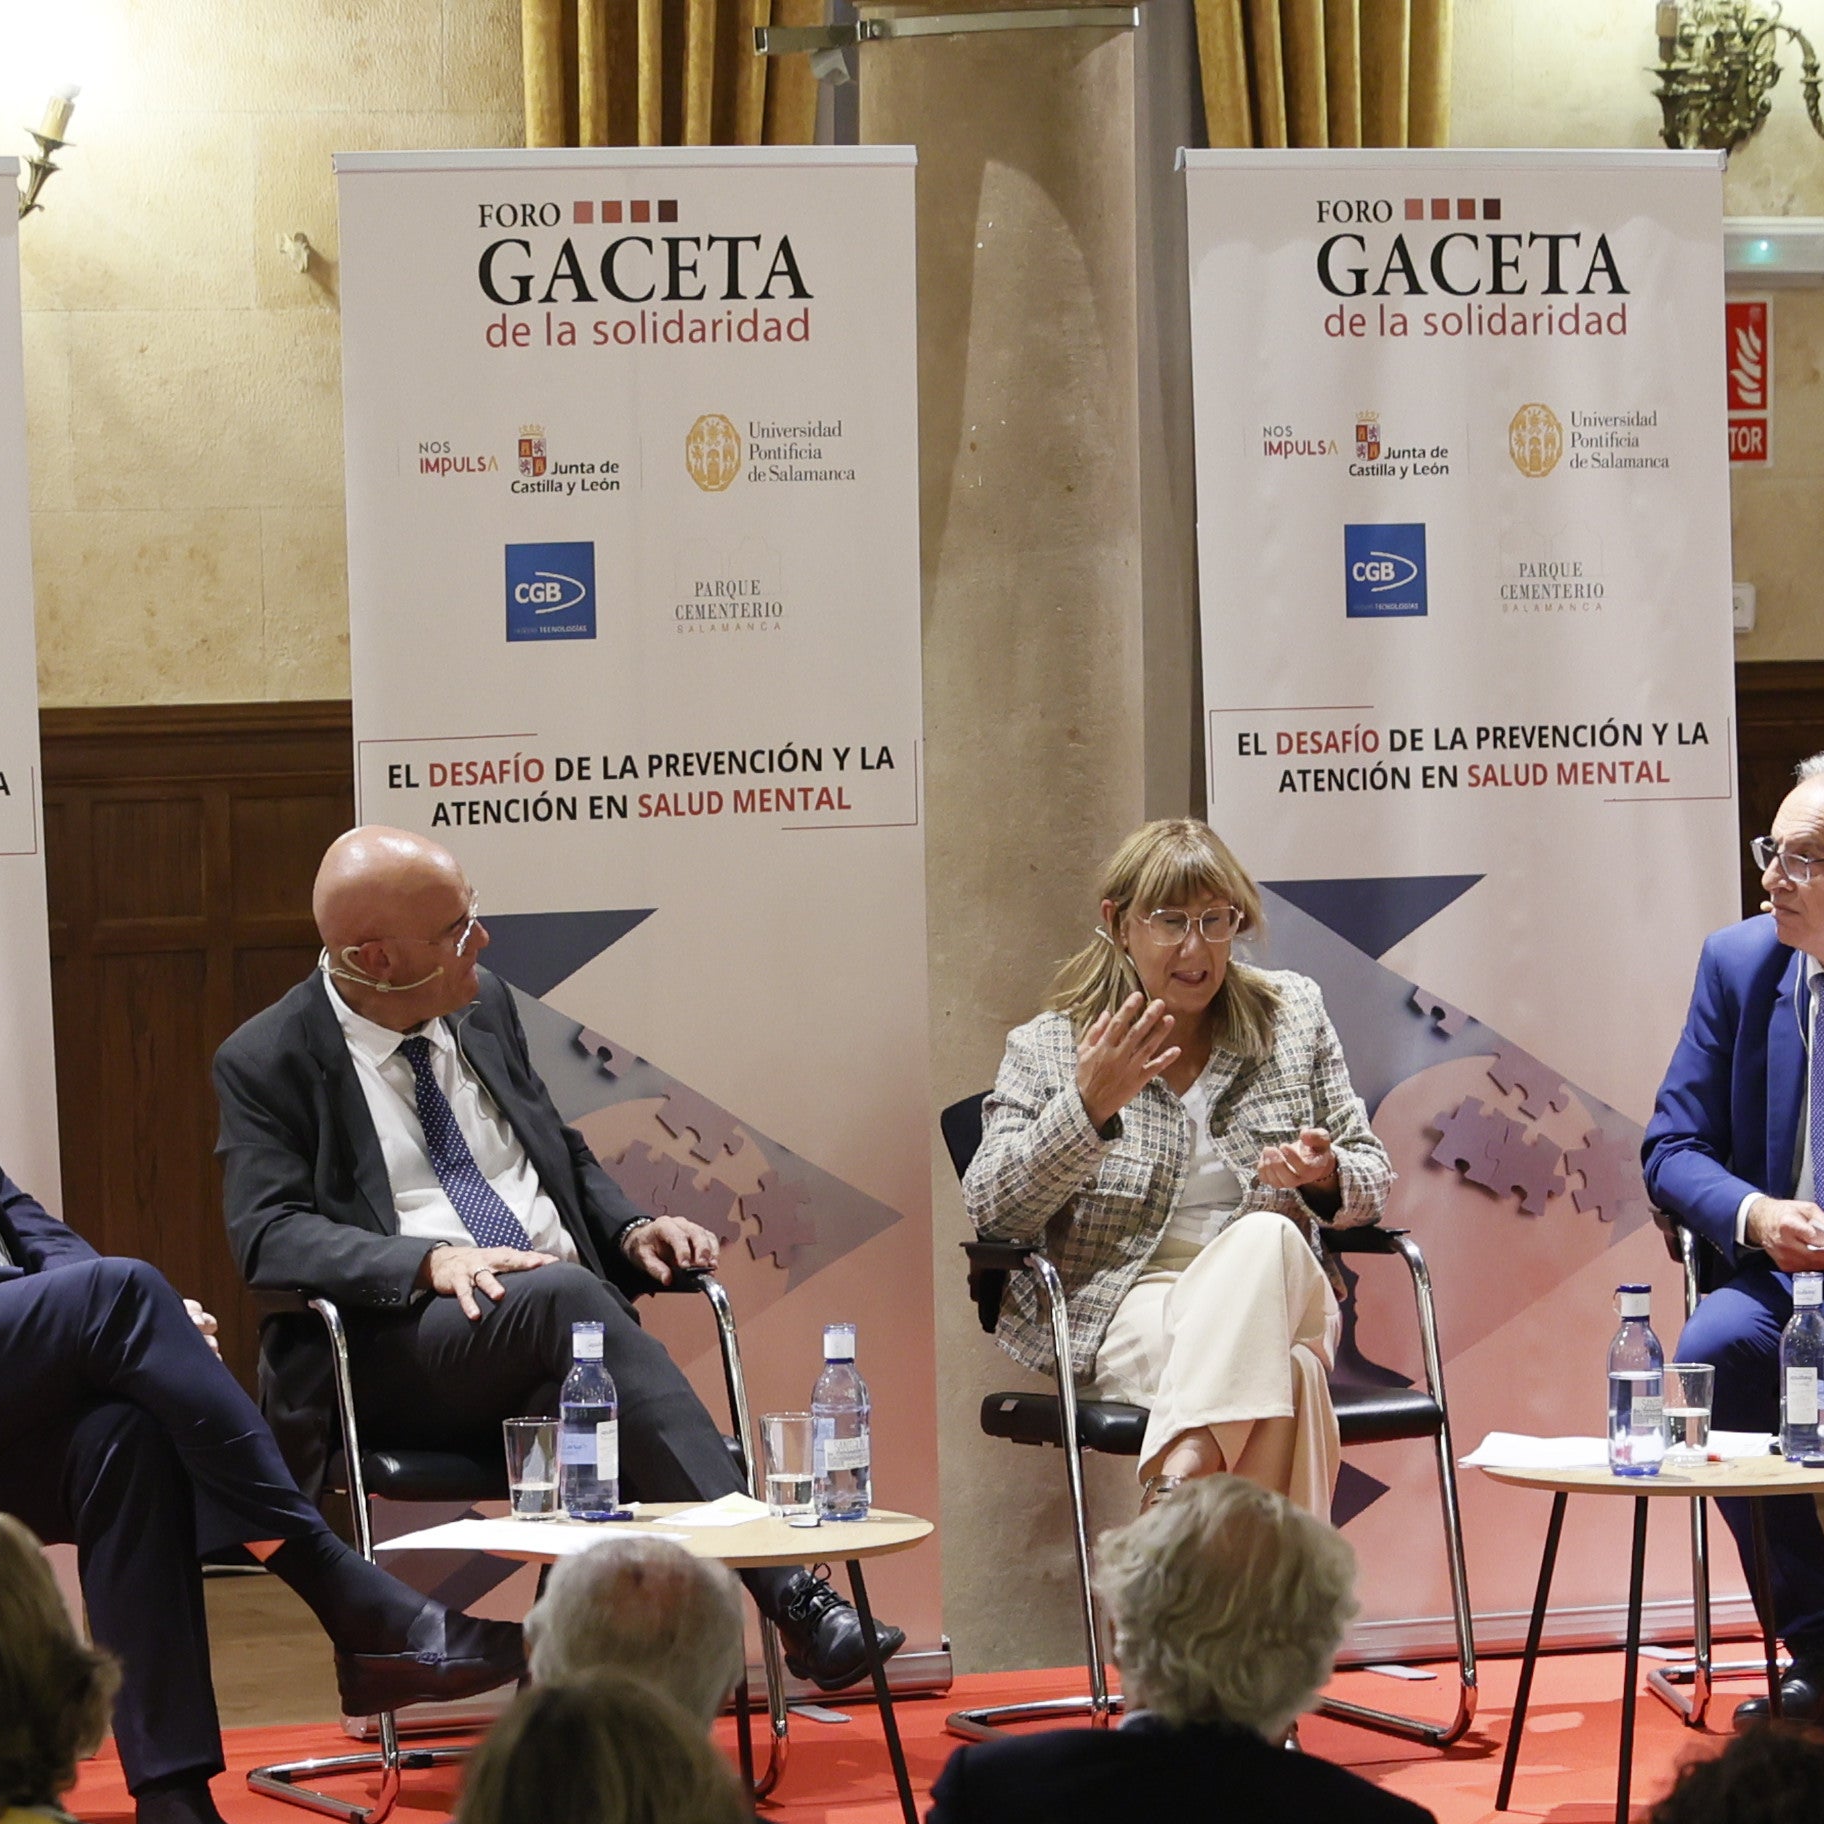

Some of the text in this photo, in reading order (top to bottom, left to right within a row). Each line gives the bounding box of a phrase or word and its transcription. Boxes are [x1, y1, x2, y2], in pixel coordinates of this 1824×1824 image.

[479, 203, 560, 227] FORO
[1317, 200, 1392, 223] FORO
[479, 234, 813, 305] GACETA
[1317, 231, 1630, 297] GACETA
[486, 308, 809, 348] de la solidaridad
[1325, 303, 1626, 337] de la solidaridad
[1572, 410, 1657, 427] Universidad
[750, 420, 841, 438] Universidad
[1263, 426, 1292, 438] NOS
[419, 441, 450, 453] NOS
[1572, 432, 1639, 448] Pontificia
[749, 443, 822, 460] Pontificia
[1384, 446, 1448, 459] Junta de
[1570, 452, 1669, 468] de Salamanca
[551, 461, 619, 475] Junta de
[748, 465, 855, 482] de Salamanca
[1349, 463, 1449, 479] Castilla y León
[511, 478, 619, 496] Castilla y León
[1353, 562, 1395, 581] CGB
[1520, 563, 1582, 581] PARQUE
[515, 583, 561, 603] CGB
[695, 580, 760, 600] PARQUE
[1501, 584, 1603, 600] CEMENTERIO
[676, 602, 782, 620] CEMENTERIO
[677, 621, 780, 633] SALAMANCA
[1239, 717, 1708, 755] EL DESAFÍO DE LA PREVENCIÓN Y LA
[389, 742, 894, 788] EL DESAFÍO DE LA PREVENCIÓN Y LA
[1279, 760, 1670, 793] ATENCIÓN EN SALUD MENTAL
[432, 787, 851, 826] ATENCIÓN EN SALUD MENTAL
